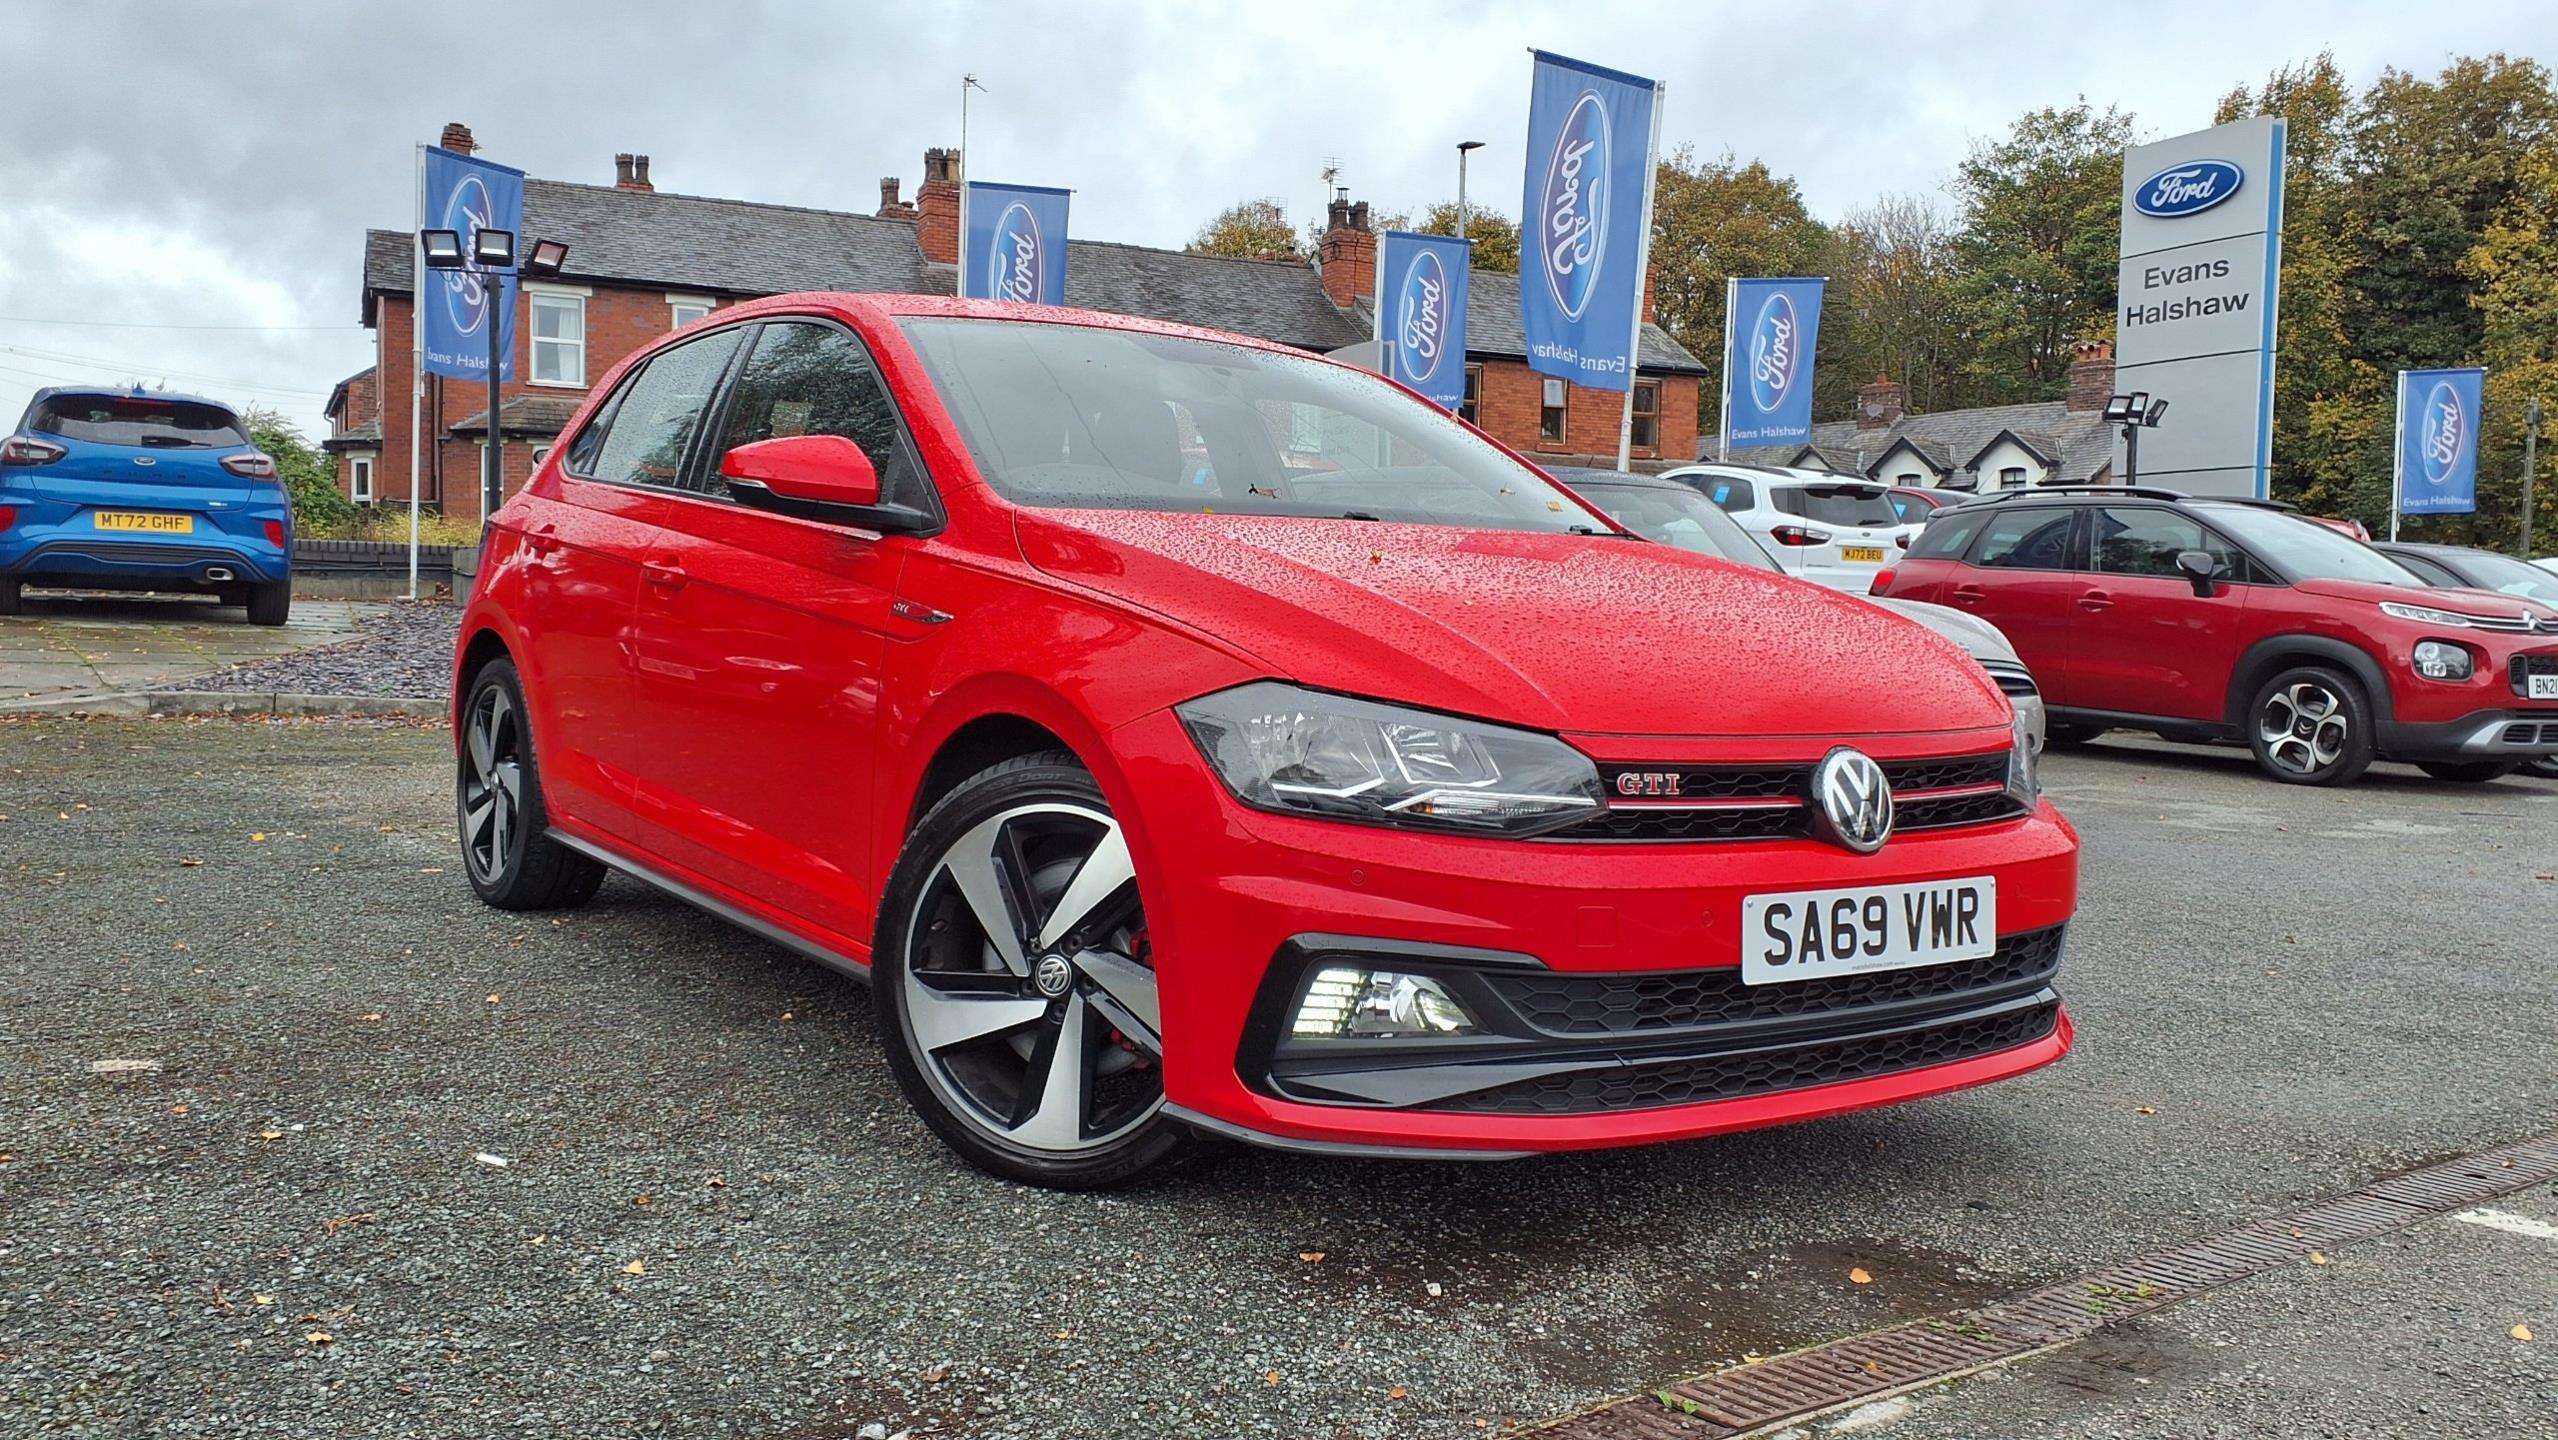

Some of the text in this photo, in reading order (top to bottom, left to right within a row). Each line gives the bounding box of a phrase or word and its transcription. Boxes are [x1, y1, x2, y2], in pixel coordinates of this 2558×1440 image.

[2151, 168, 2218, 208] Ford
[2144, 259, 2230, 290] Evans
[1405, 276, 1441, 358] Ford
[2126, 293, 2250, 328] Halshaw
[456, 353, 508, 371] Halsw
[1756, 316, 1792, 390] Ford
[1731, 426, 1806, 440] Evans Halshaw
[2428, 402, 2459, 464] Ford
[2403, 495, 2471, 508] Evans Halshaw
[101, 513, 185, 530] MT72 GHF
[1616, 772, 1681, 796] GTI
[1763, 886, 1979, 966] SA69 VWR
